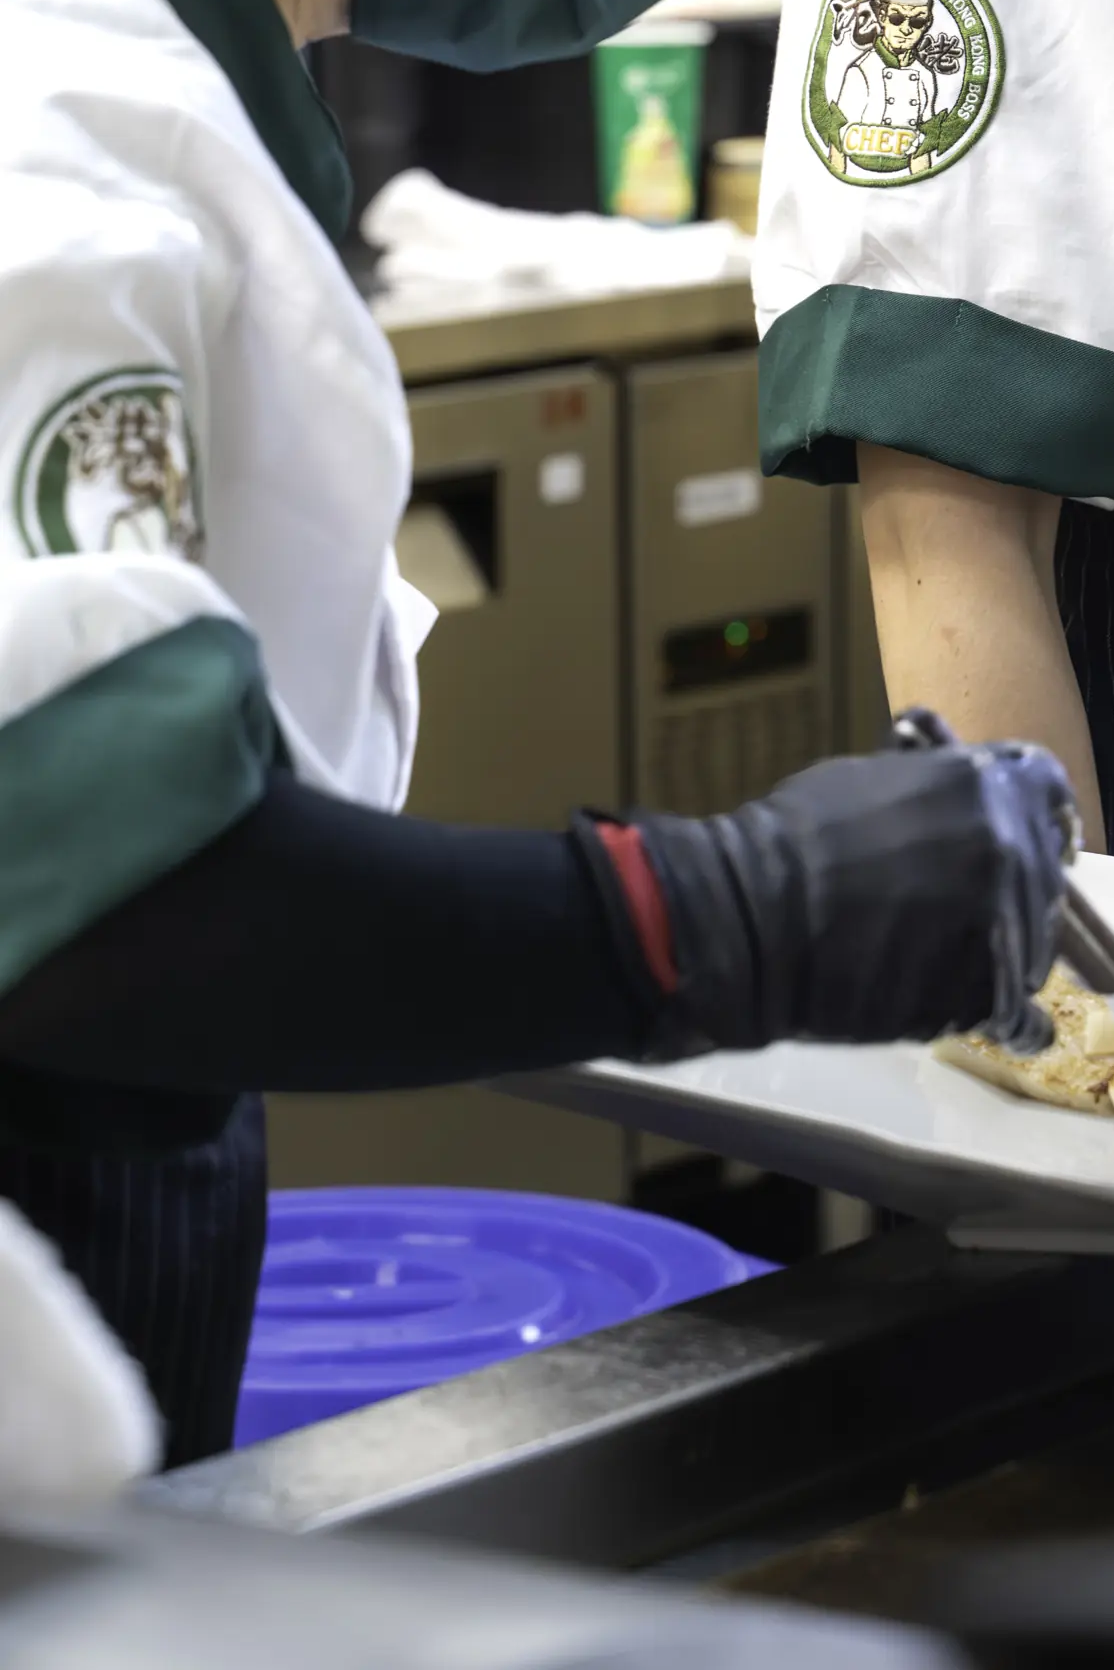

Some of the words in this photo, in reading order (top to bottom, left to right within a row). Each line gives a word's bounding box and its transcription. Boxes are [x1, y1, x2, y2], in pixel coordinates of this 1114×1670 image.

[969, 34, 985, 76] KONG
[957, 82, 981, 120] BOSS
[845, 127, 915, 156] CHEF
